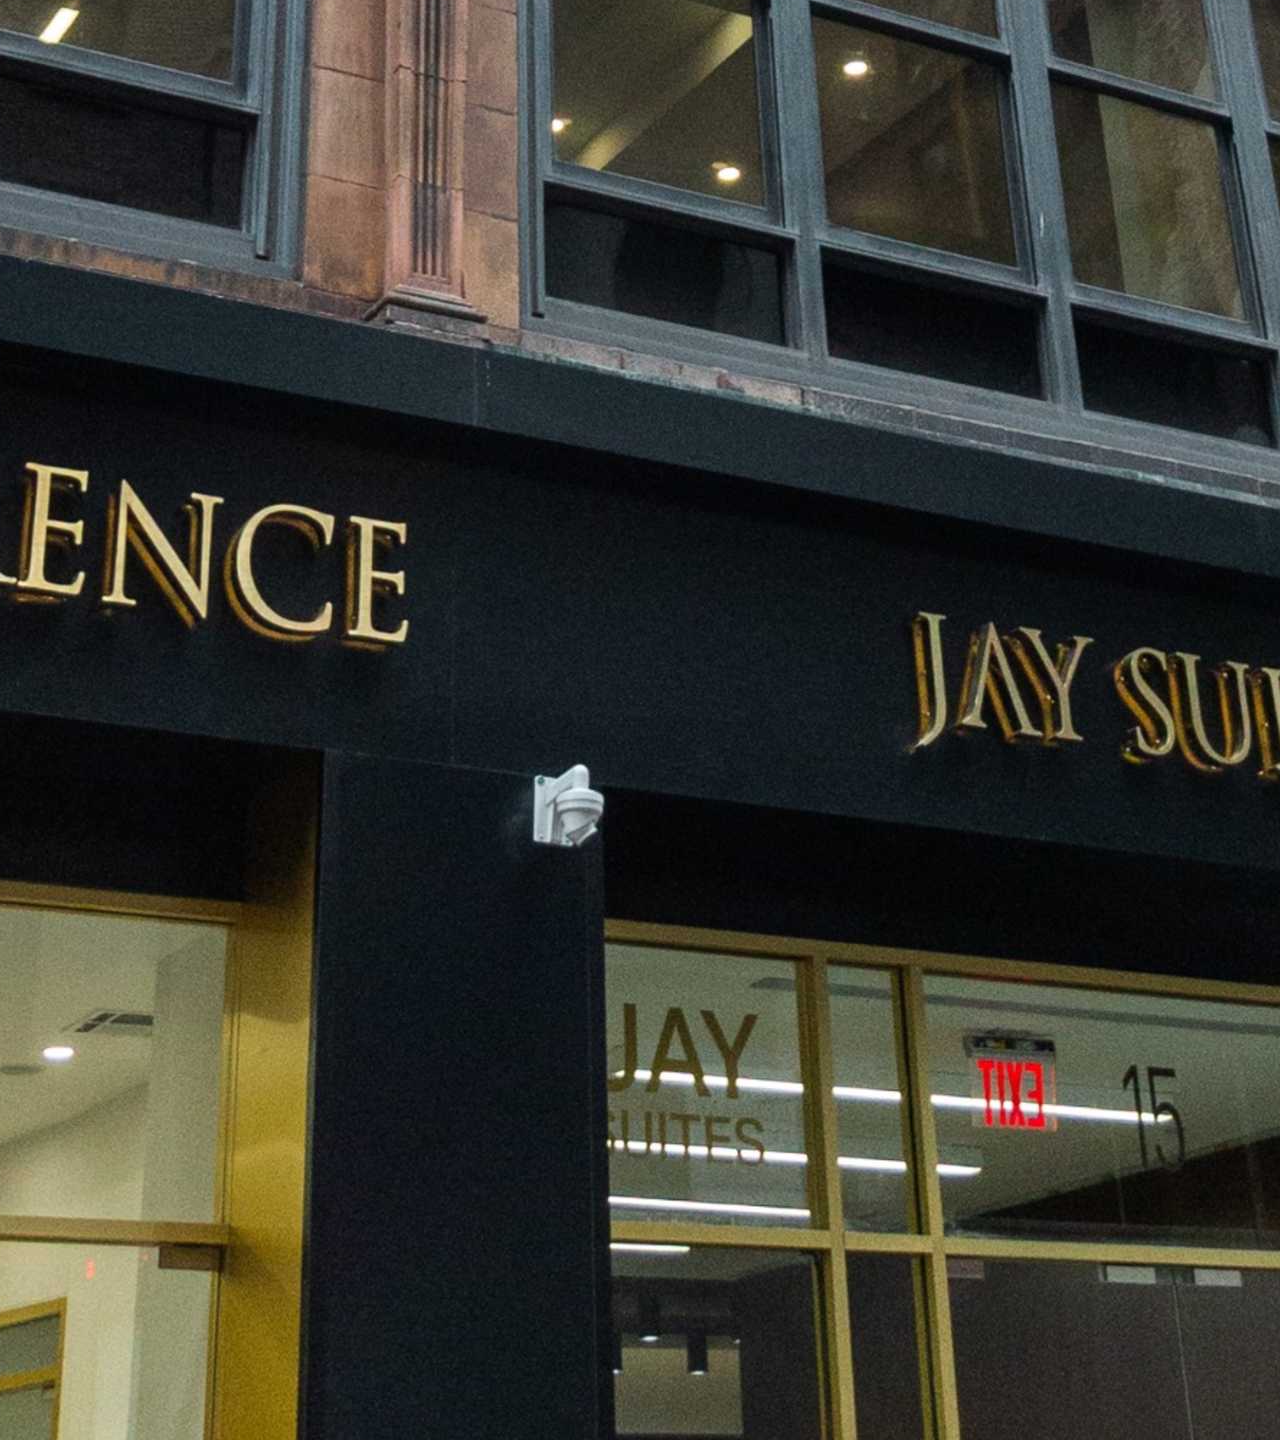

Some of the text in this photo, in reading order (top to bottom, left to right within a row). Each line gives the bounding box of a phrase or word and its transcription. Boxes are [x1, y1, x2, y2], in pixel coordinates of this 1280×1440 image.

[908, 610, 1094, 751] JAY
[607, 1003, 759, 1099] JAY
[1123, 1064, 1185, 1172] 15
